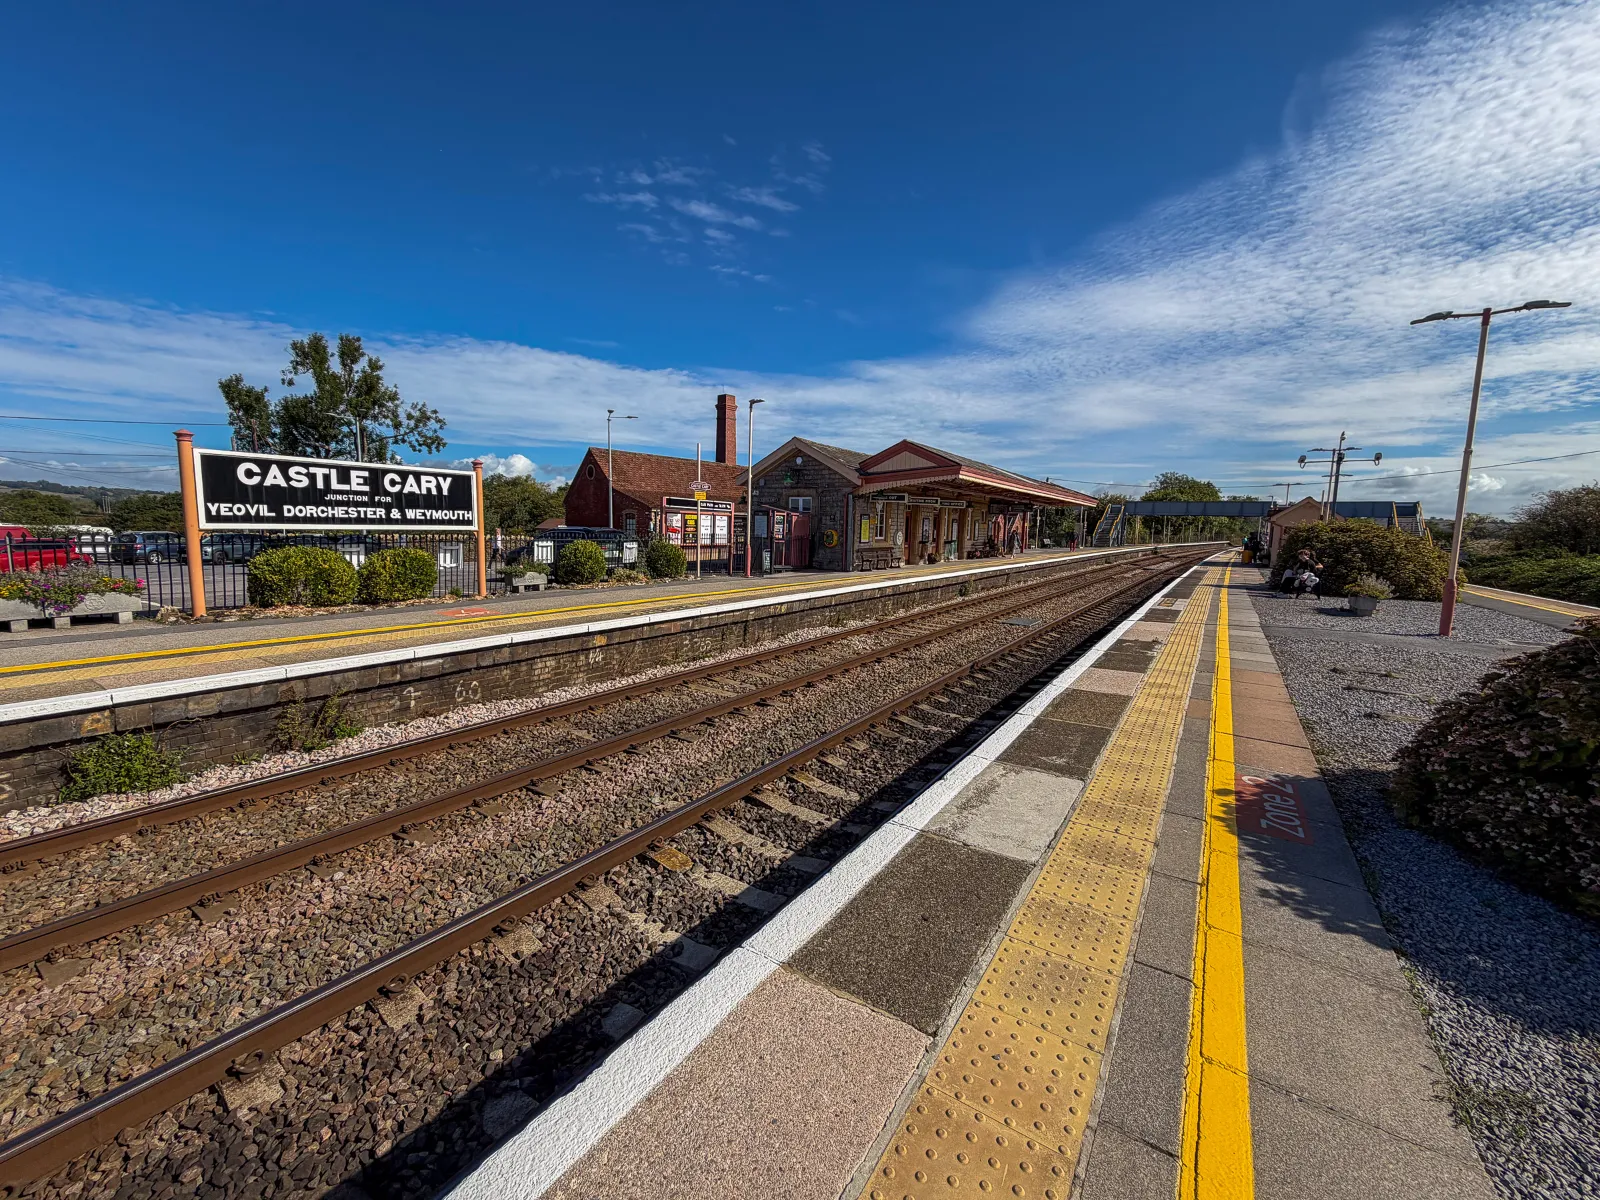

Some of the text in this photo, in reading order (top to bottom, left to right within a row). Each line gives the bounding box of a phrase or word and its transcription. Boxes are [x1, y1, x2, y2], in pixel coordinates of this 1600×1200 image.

[236, 462, 453, 496] CASTLE CARY
[324, 494, 369, 502] JUNCTION
[206, 503, 473, 520] YEOVIL DORCHESTER & WEYMOUTH
[1241, 775, 1305, 838] Zone 2
